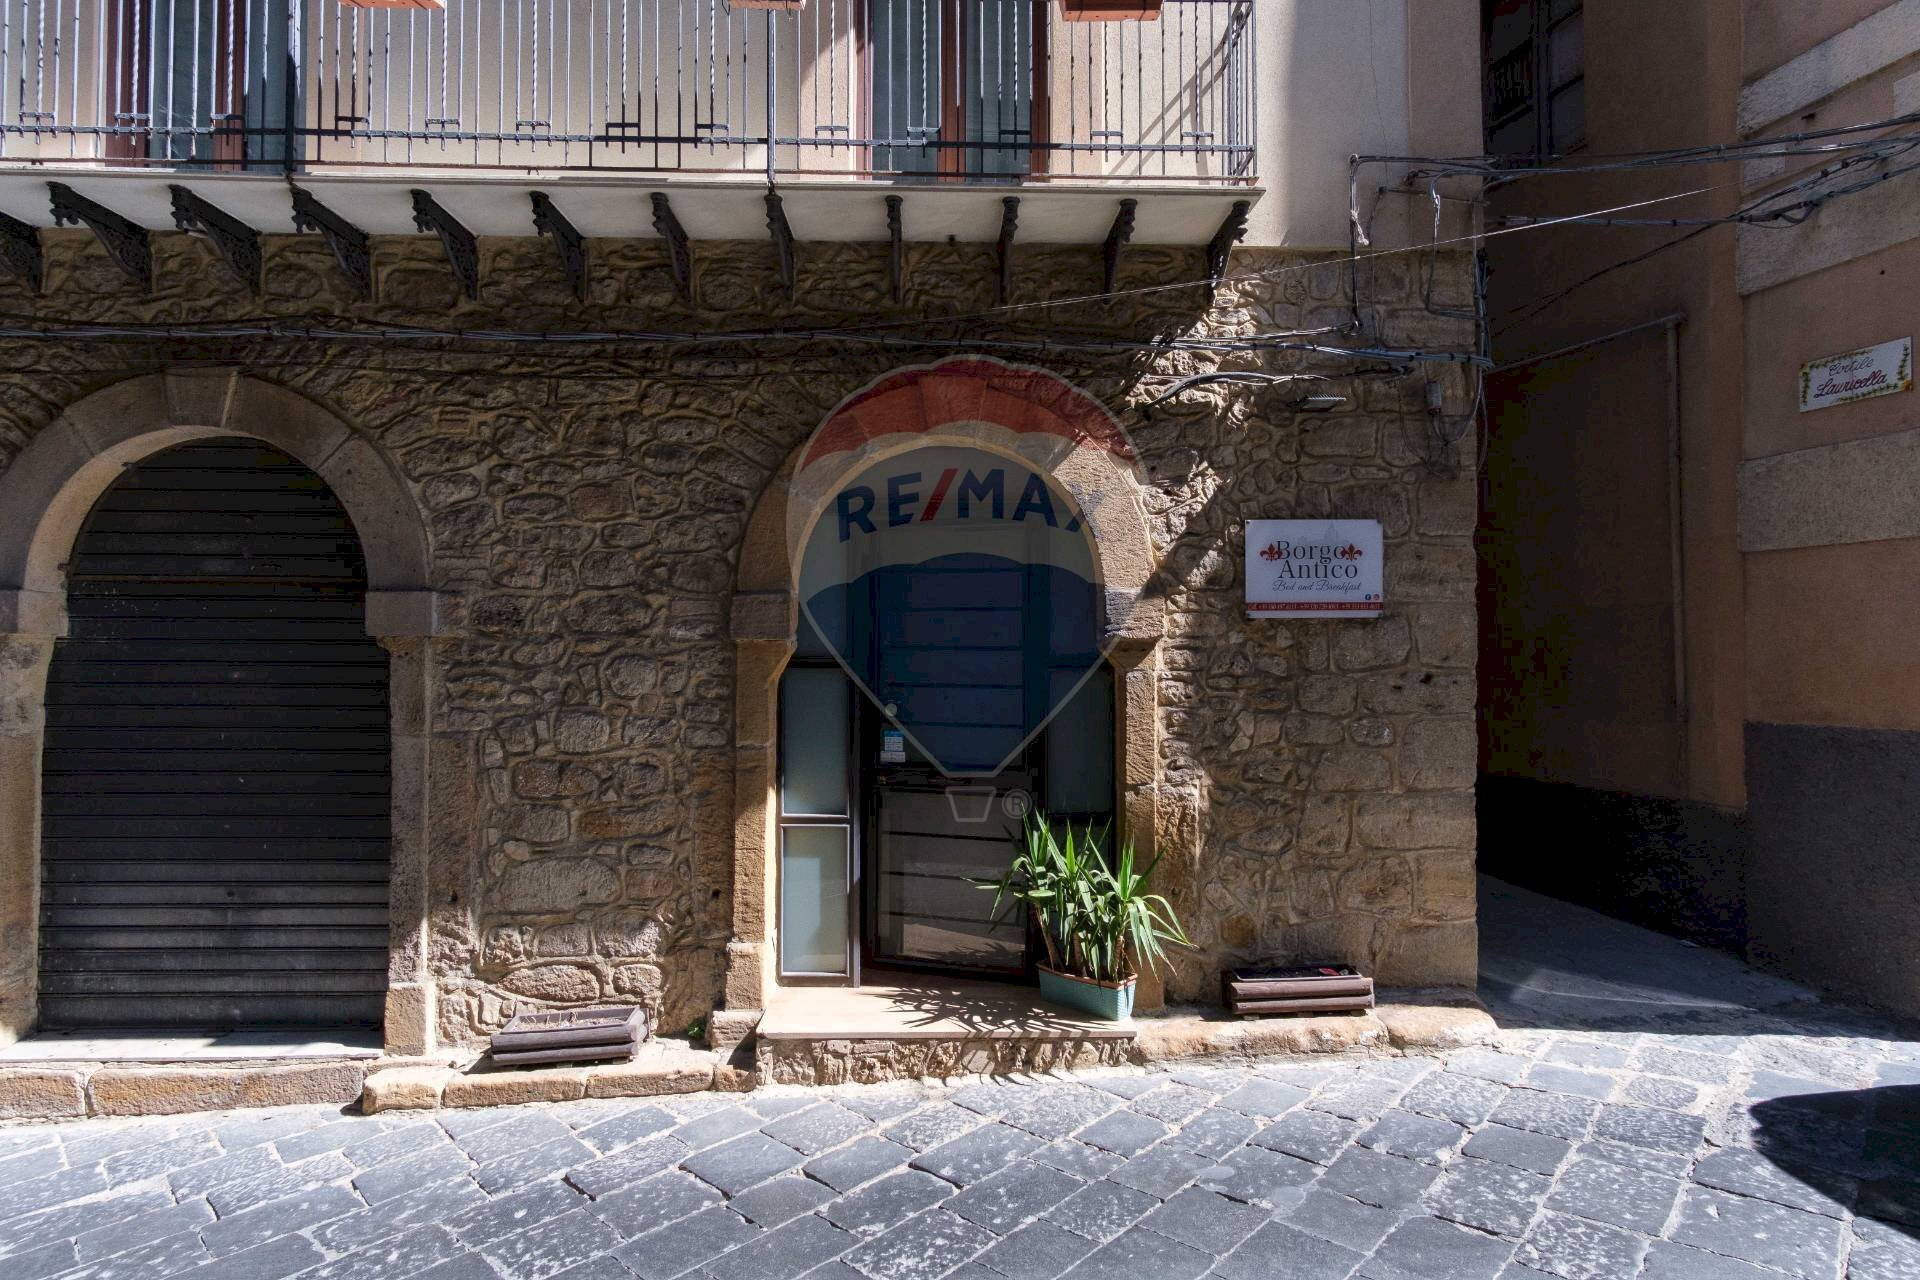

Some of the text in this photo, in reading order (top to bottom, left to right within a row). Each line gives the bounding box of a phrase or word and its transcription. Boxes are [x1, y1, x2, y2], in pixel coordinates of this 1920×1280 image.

[1829, 356, 1874, 376] Cortile
[1814, 369, 1887, 398] Lauricella
[1276, 540, 1345, 564] Borgo
[1278, 559, 1358, 579] Antico
[1272, 580, 1361, 594] Bed and Breakfast
